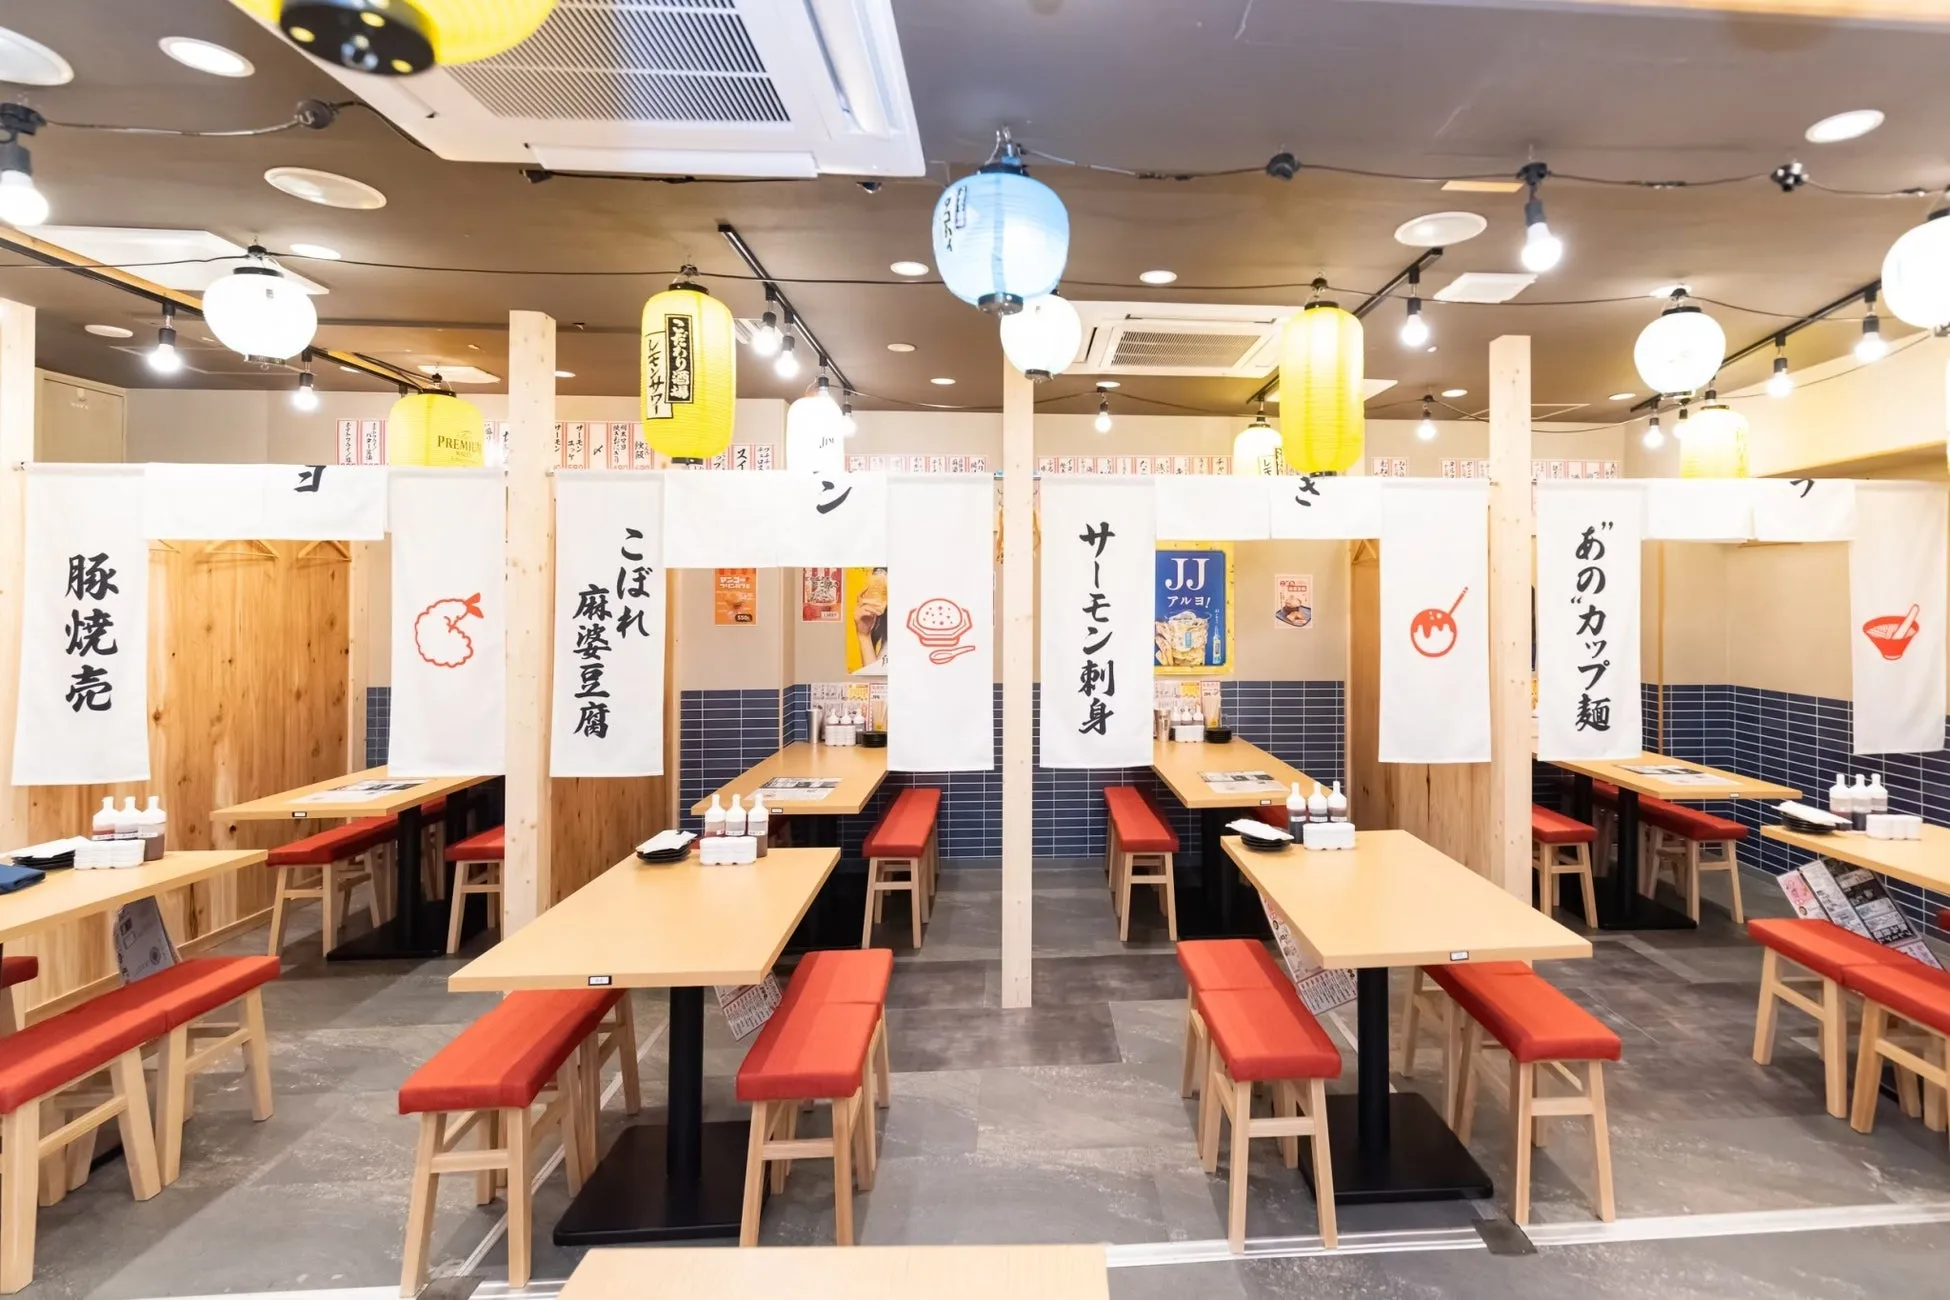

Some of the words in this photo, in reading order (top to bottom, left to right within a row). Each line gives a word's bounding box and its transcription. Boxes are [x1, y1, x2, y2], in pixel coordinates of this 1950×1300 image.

[648, 339, 665, 415] レモンサワー
[670, 318, 690, 399] こだわり酒場
[616, 527, 653, 639] こぼれ
[1078, 521, 1116, 736] サーモン刺身
[1165, 558, 1210, 591] JJ
[64, 552, 120, 714] 豚焼売
[572, 583, 613, 739] 麻婆豆腐
